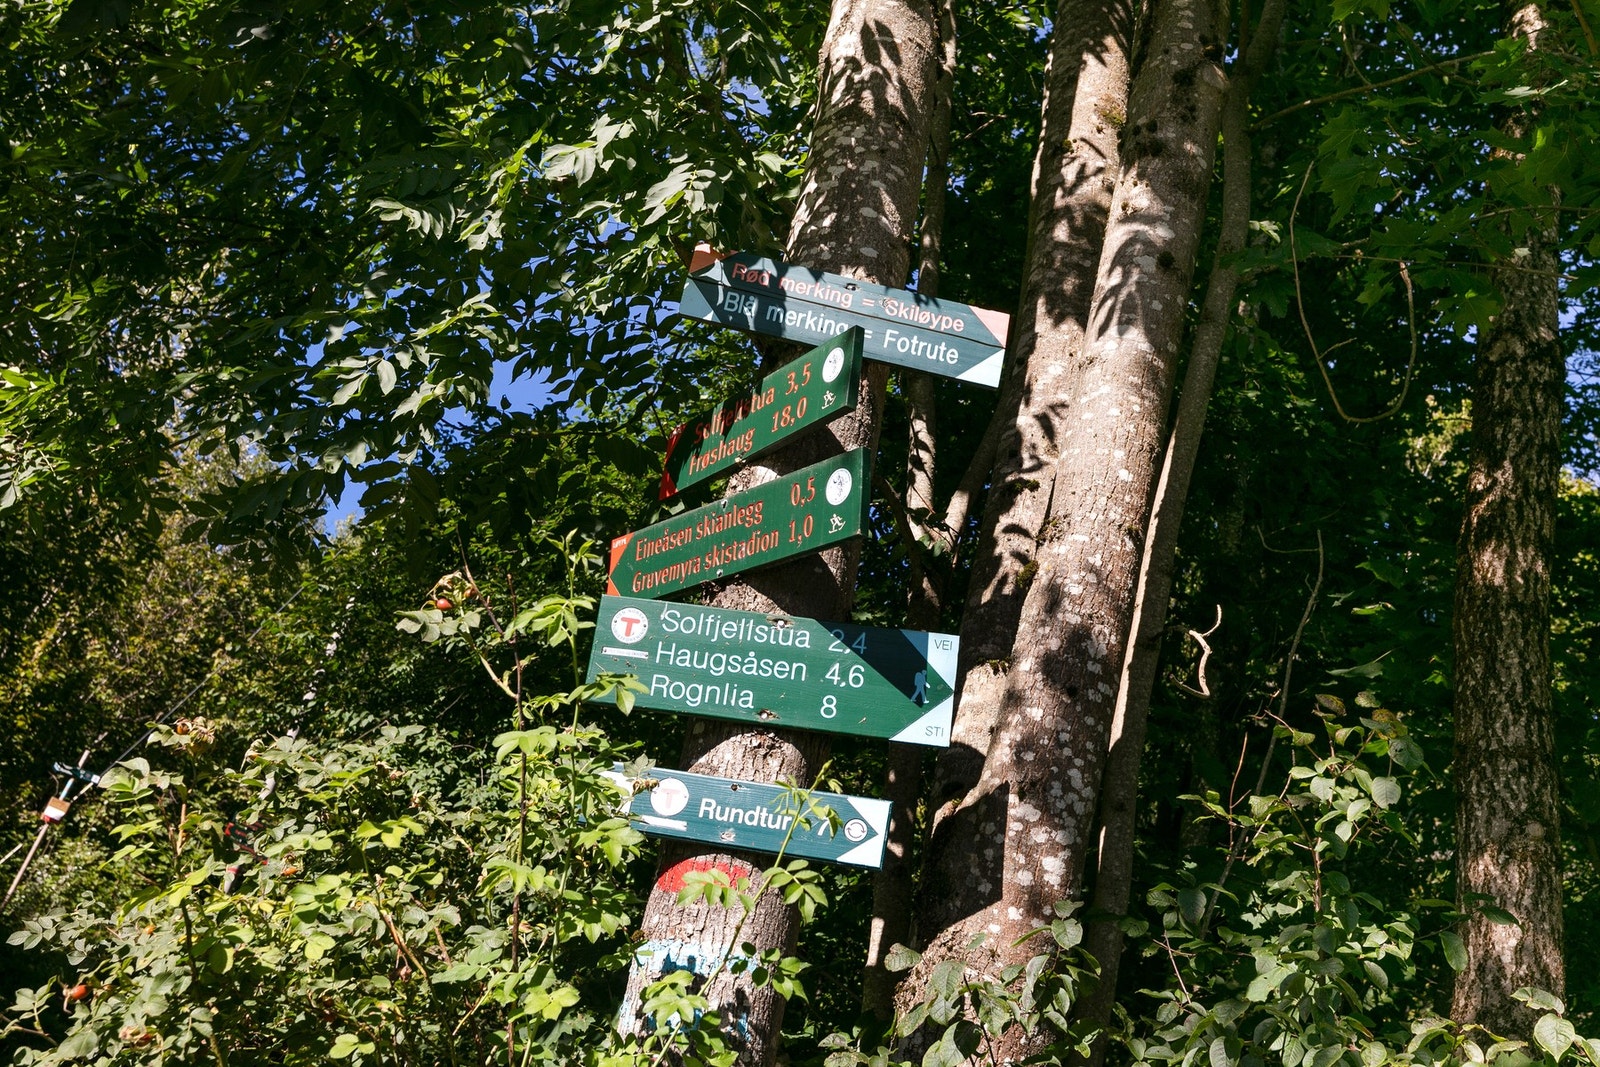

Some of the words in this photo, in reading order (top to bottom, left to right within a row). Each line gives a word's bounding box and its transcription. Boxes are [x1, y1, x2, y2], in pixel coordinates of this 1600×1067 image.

[731, 262, 770, 286] Rød
[779, 277, 853, 307] merking
[883, 298, 966, 333] Skiløype
[723, 291, 756, 317] Blå
[883, 329, 960, 365] Fotrute
[785, 362, 812, 396] 3,5
[688, 427, 755, 475] Frøshaug
[771, 396, 808, 433] 18,0
[635, 526, 693, 561] Eineåsen
[695, 500, 764, 541] skianlegg
[790, 477, 816, 508] 0,5
[632, 556, 701, 594] Gruvemyra
[704, 528, 779, 570] skistadion
[788, 513, 814, 548] 1,0
[620, 616, 641, 637] T
[661, 609, 811, 649] Solfjellstua
[828, 629, 868, 655] 2,4
[934, 638, 954, 651] VEI
[655, 641, 807, 682] Haugsåsen
[825, 662, 865, 689] 4,6
[650, 673, 755, 710] Rognlia
[820, 695, 838, 719] 8
[925, 725, 945, 738] STI
[699, 797, 793, 831] Rundtur
